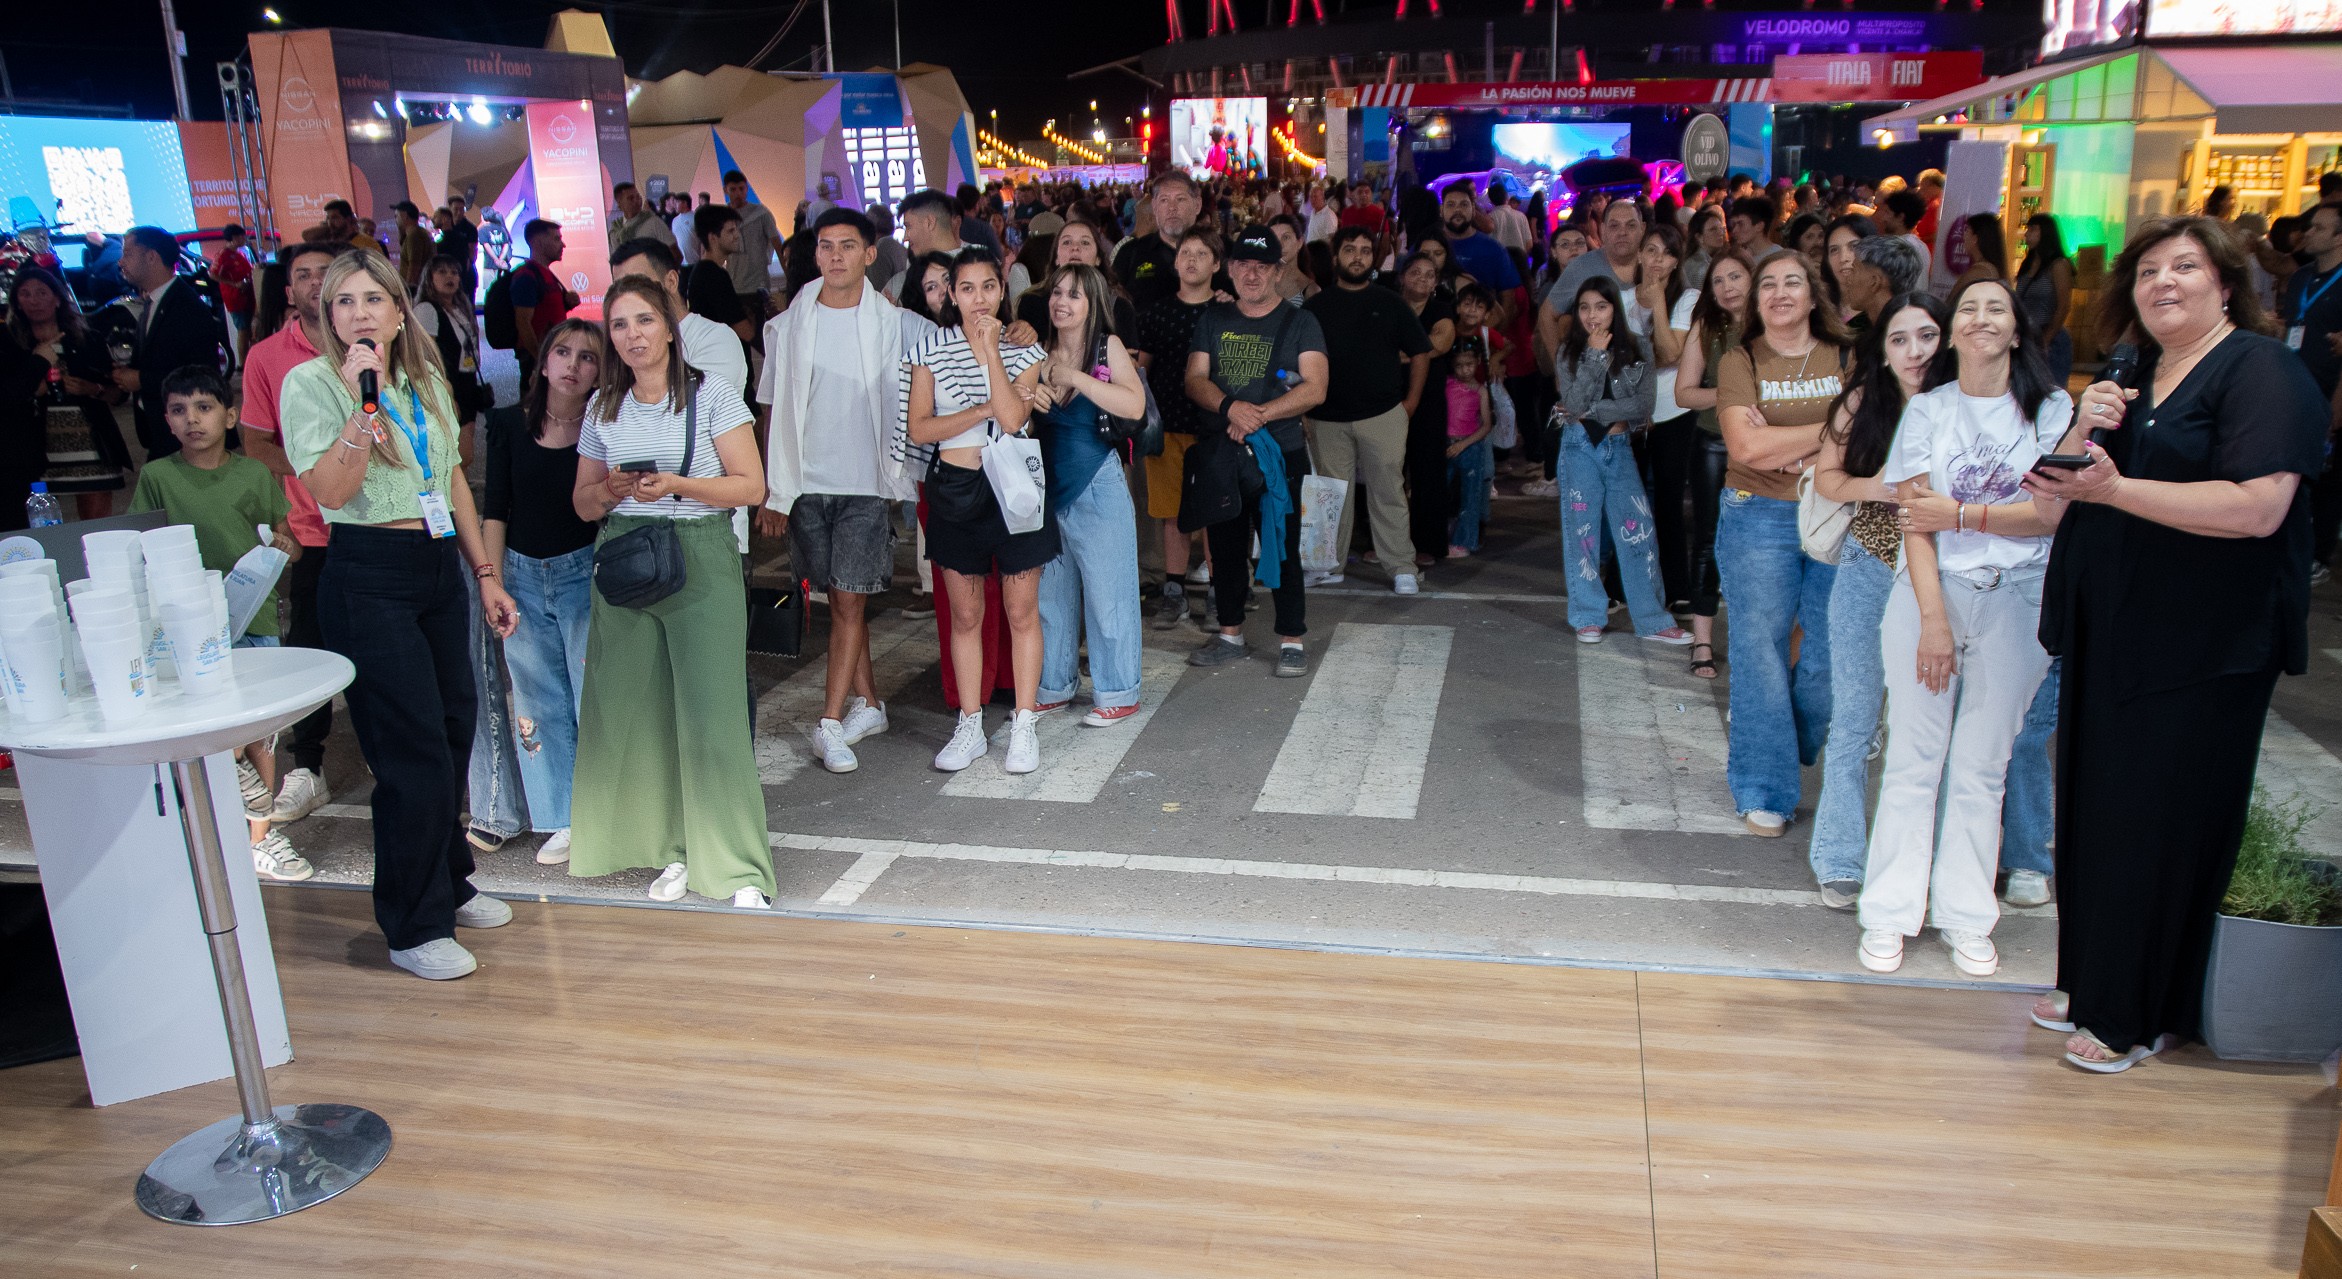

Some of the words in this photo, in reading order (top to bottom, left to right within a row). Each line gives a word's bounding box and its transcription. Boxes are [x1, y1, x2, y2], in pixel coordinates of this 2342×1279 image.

[1745, 19, 1850, 35] VELODROMO
[465, 51, 532, 78] TERRITORIO
[1828, 60, 1871, 85] ITALA
[1891, 59, 1926, 85] FIAT
[280, 90, 316, 99] NISSAN
[1482, 88, 1498, 99] LA
[1502, 84, 1552, 99] PASIÓN
[1556, 87, 1587, 98] NOS
[1590, 86, 1636, 98] MUEVE
[276, 118, 331, 131] YACOPINI
[1700, 135, 1715, 149] VID
[543, 147, 588, 158] YACOPINI
[1694, 152, 1720, 166] OLIVO
[549, 206, 595, 219] BYD
[1218, 340, 1273, 361] STREET
[1218, 358, 1269, 379] SKATE
[1227, 376, 1251, 386] NYC
[1760, 375, 1842, 401] DREAMING
